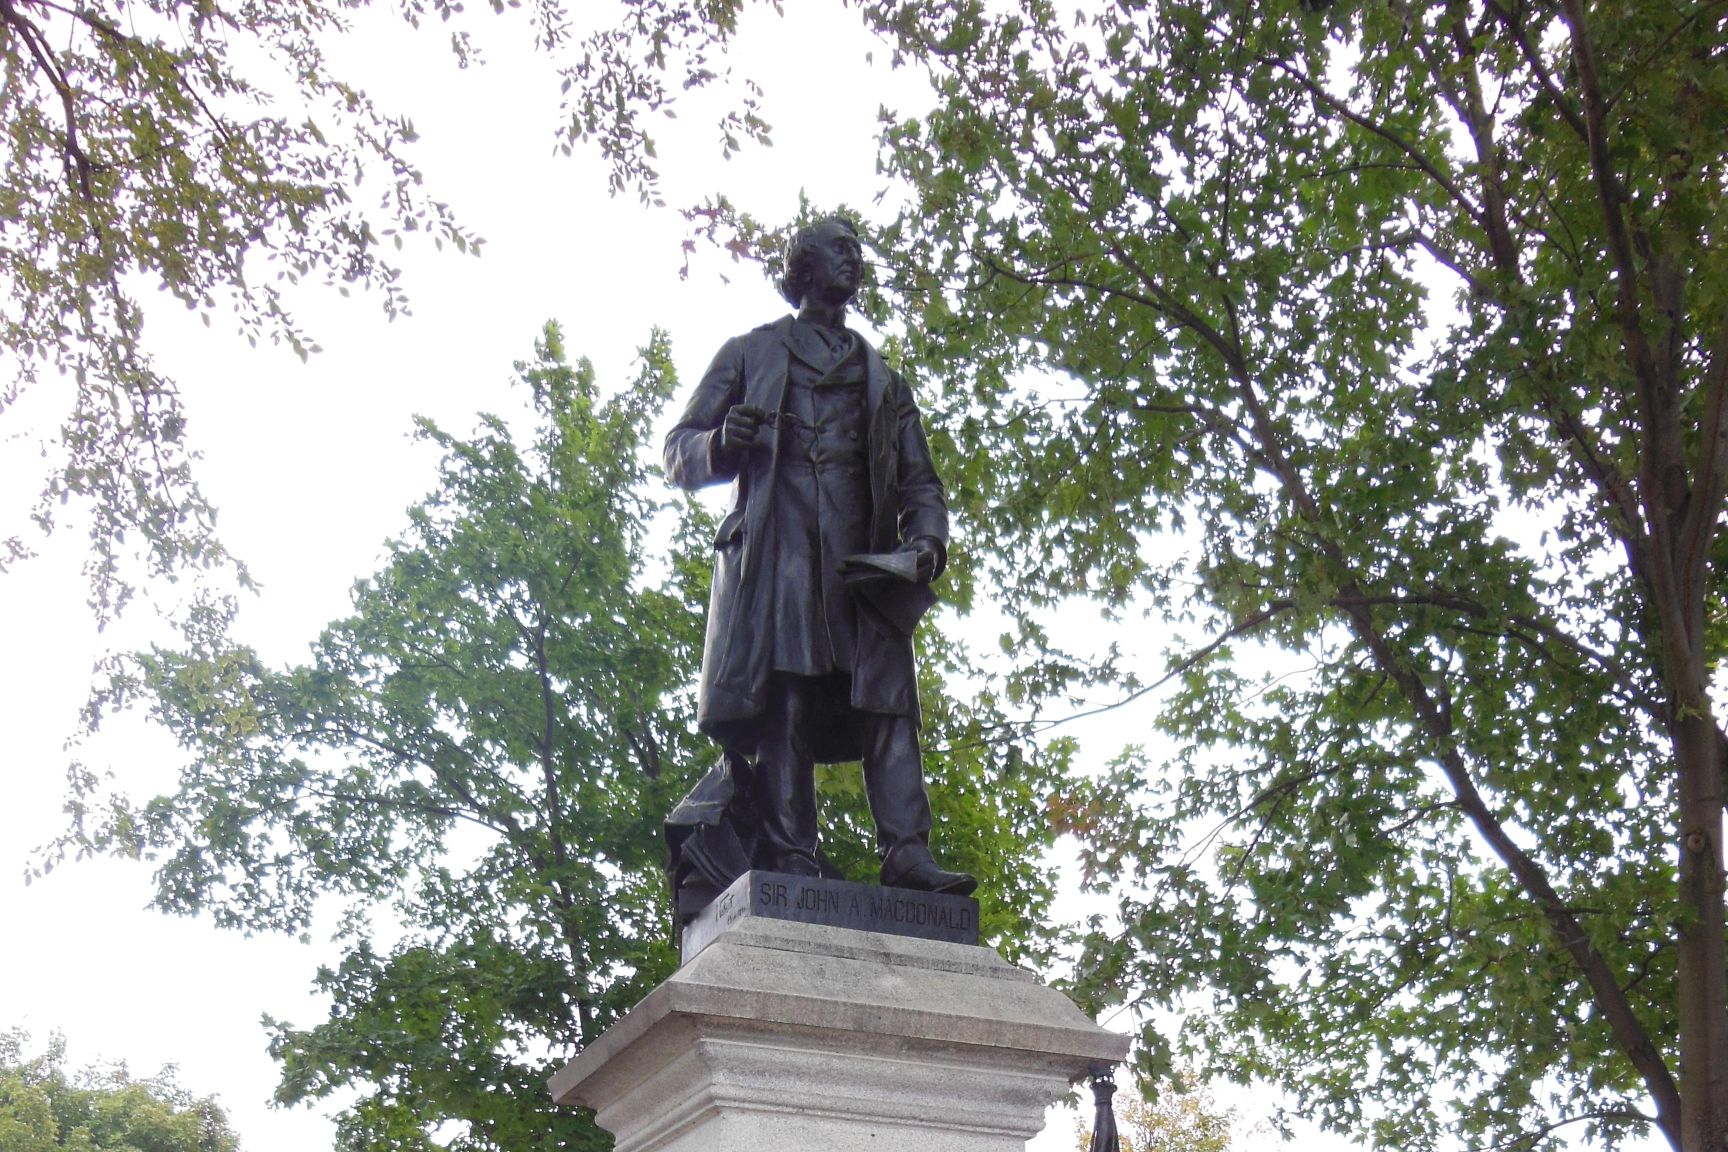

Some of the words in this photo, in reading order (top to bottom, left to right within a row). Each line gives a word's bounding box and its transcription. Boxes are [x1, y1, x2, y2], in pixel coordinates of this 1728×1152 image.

[760, 882, 787, 907] SIR
[797, 887, 840, 913] JOHN
[870, 897, 971, 931] MACDONALD
